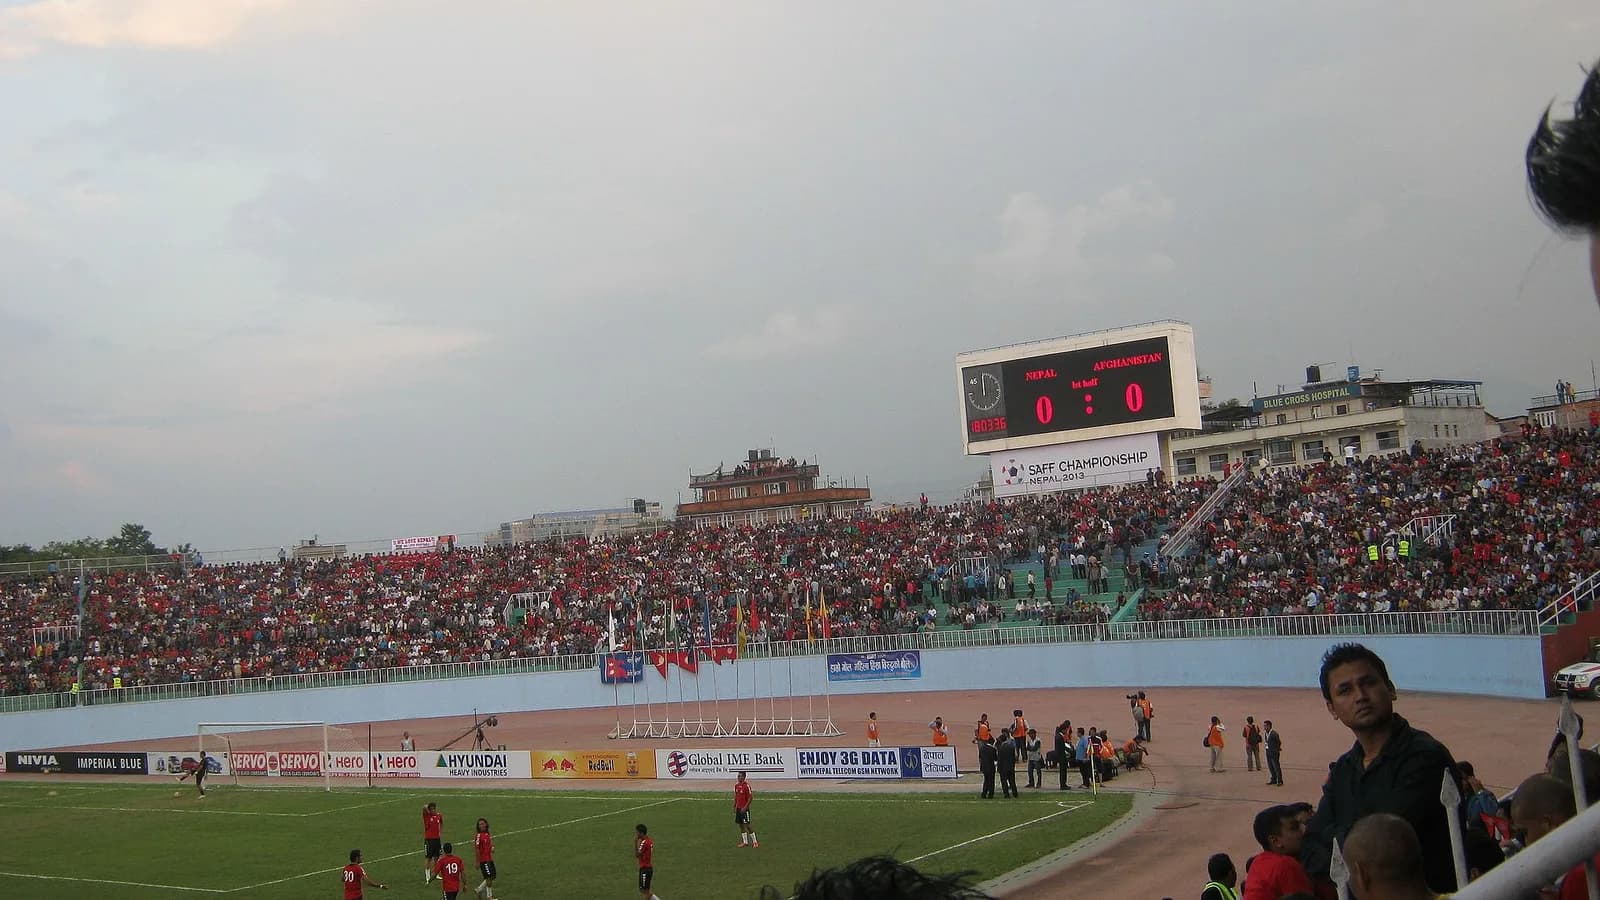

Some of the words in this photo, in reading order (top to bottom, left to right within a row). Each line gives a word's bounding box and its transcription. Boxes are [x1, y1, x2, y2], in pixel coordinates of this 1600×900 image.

[1093, 352, 1162, 371] AFGHANISTAN
[1025, 369, 1057, 381] NEPAL
[1083, 377, 1098, 387] half
[1036, 396, 1053, 424] 0
[1125, 383, 1144, 412] 0
[1263, 398, 1283, 408] BLUE
[1284, 395, 1309, 405] CROSS
[1311, 388, 1350, 401] HOSPITAL
[1028, 463, 1055, 476] SAFF
[1058, 451, 1148, 472] CHAMPIONSHIP
[1029, 475, 1059, 485] NEPAL
[1062, 472, 1085, 481] 2013
[18, 754, 59, 765] NIVIA
[231, 753, 266, 769] SERVO
[280, 753, 320, 769] SERVO
[448, 754, 507, 768] HYUNDAI
[688, 752, 722, 766] Global
[727, 753, 751, 765] IME
[755, 752, 784, 765] Bank
[799, 751, 837, 765] ENJOY
[840, 751, 859, 765] 3G
[861, 751, 897, 765] DATA
[923, 749, 945, 759] नेपाल
[77, 758, 117, 769] IMPERIAL
[120, 758, 142, 769] BLUE
[387, 755, 417, 769] Hero
[471, 768, 508, 777] INDUSTRIES
[446, 862, 458, 875] 19
[343, 870, 354, 882] 30
